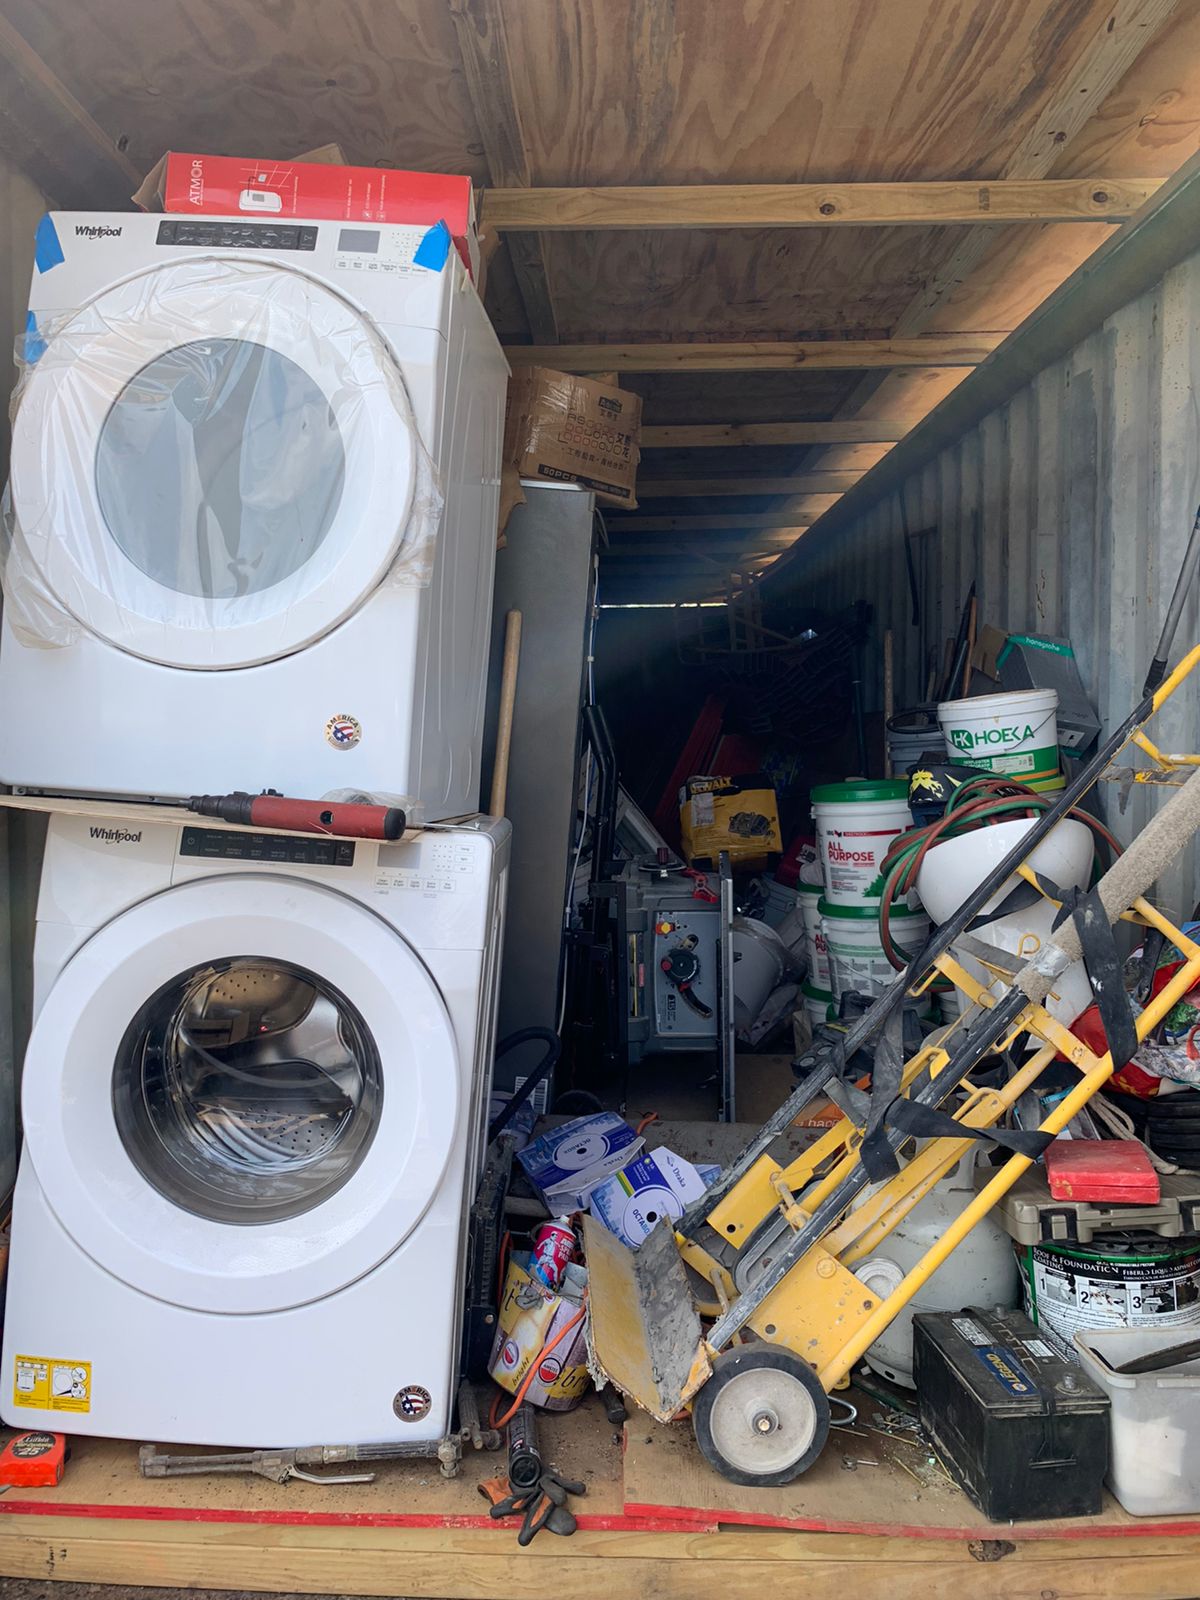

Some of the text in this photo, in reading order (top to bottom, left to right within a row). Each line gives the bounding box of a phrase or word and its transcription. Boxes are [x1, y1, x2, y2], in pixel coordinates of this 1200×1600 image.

[189, 160, 203, 206] ATMOR
[75, 225, 122, 240] Whirlpool
[1025, 637, 1060, 651] hansgrohe
[326, 714, 359, 730] AMERICA
[90, 826, 142, 844] Whirlpool
[828, 841, 844, 852] ALL
[828, 851, 875, 861] PURPOSE
[672, 1167, 686, 1189] Draka
[1033, 1246, 1119, 1274] ROOF & FOUNDATION
[1033, 1253, 1064, 1271] COATING
[1040, 1278, 1046, 1291] 1
[1080, 1291, 1089, 1304] 2
[1132, 1296, 1142, 1309] 3
[511, 1356, 530, 1386] bright
[398, 1387, 430, 1404] AMERICA
